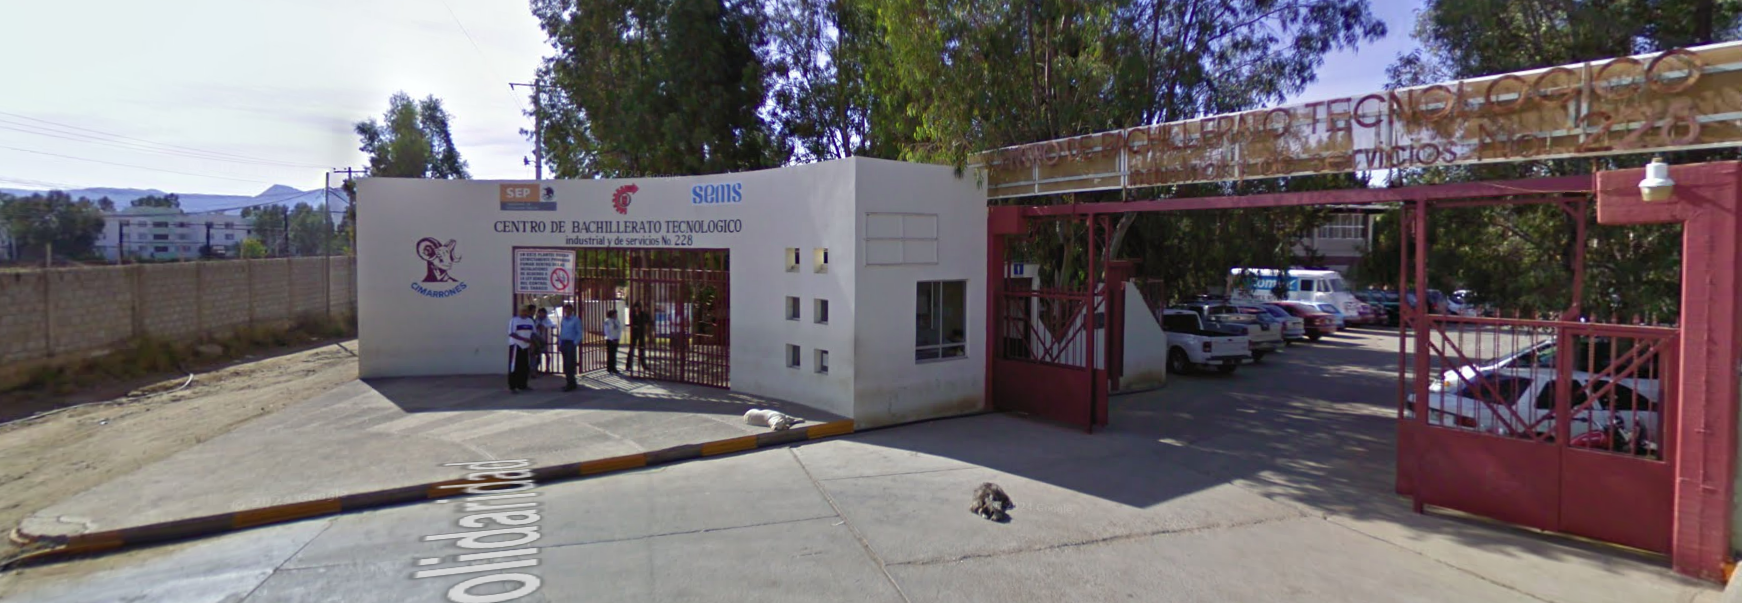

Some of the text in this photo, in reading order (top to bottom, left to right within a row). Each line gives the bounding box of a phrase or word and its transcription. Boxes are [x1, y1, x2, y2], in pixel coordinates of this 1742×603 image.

[1304, 48, 1701, 134] TECNOLOGICO
[505, 186, 531, 199] SEP
[494, 218, 742, 234] CENTRO DE BACHILLERATO TECNOLOGICO
[565, 235, 606, 246] industrial
[607, 238, 612, 249] y
[614, 235, 624, 246] de
[625, 235, 660, 246] servicios
[674, 234, 694, 247] 228
[411, 281, 468, 299] CIMARRONES
